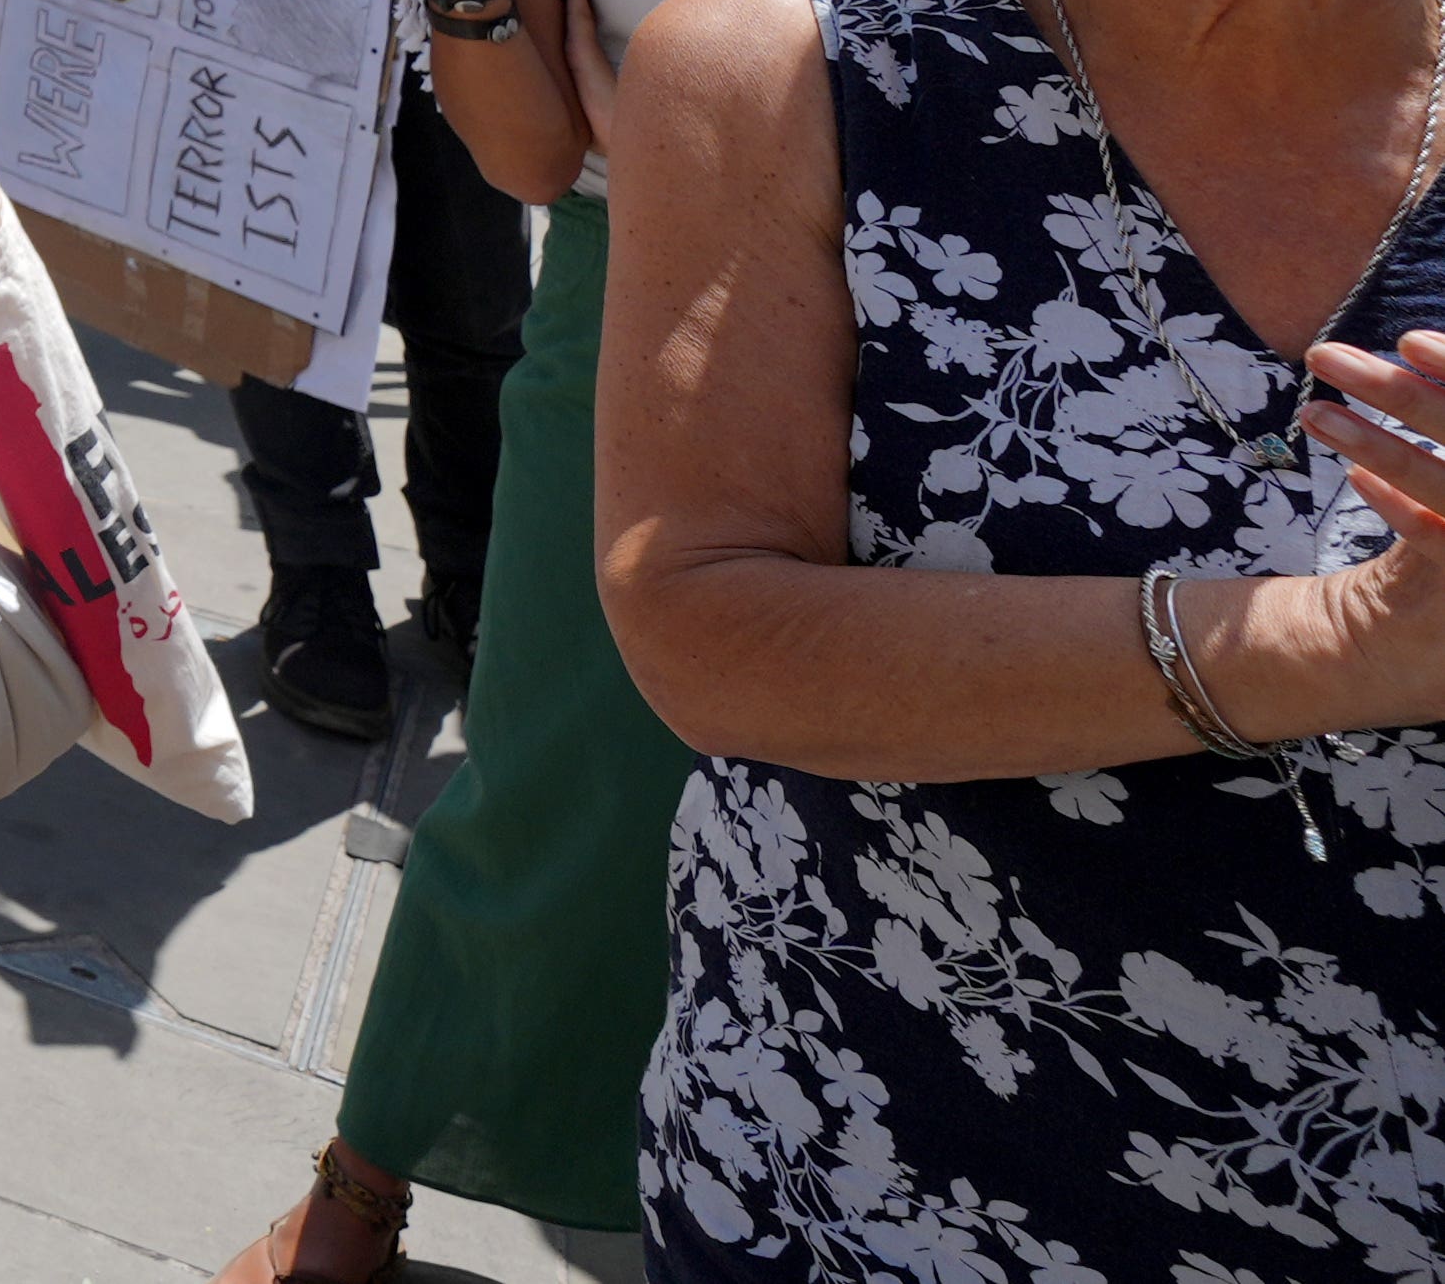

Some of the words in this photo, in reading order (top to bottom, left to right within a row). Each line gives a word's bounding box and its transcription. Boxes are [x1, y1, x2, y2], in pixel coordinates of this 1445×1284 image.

[18, 7, 106, 180] WERE
[166, 65, 237, 238] TERROR
[241, 115, 308, 259] ISTS
